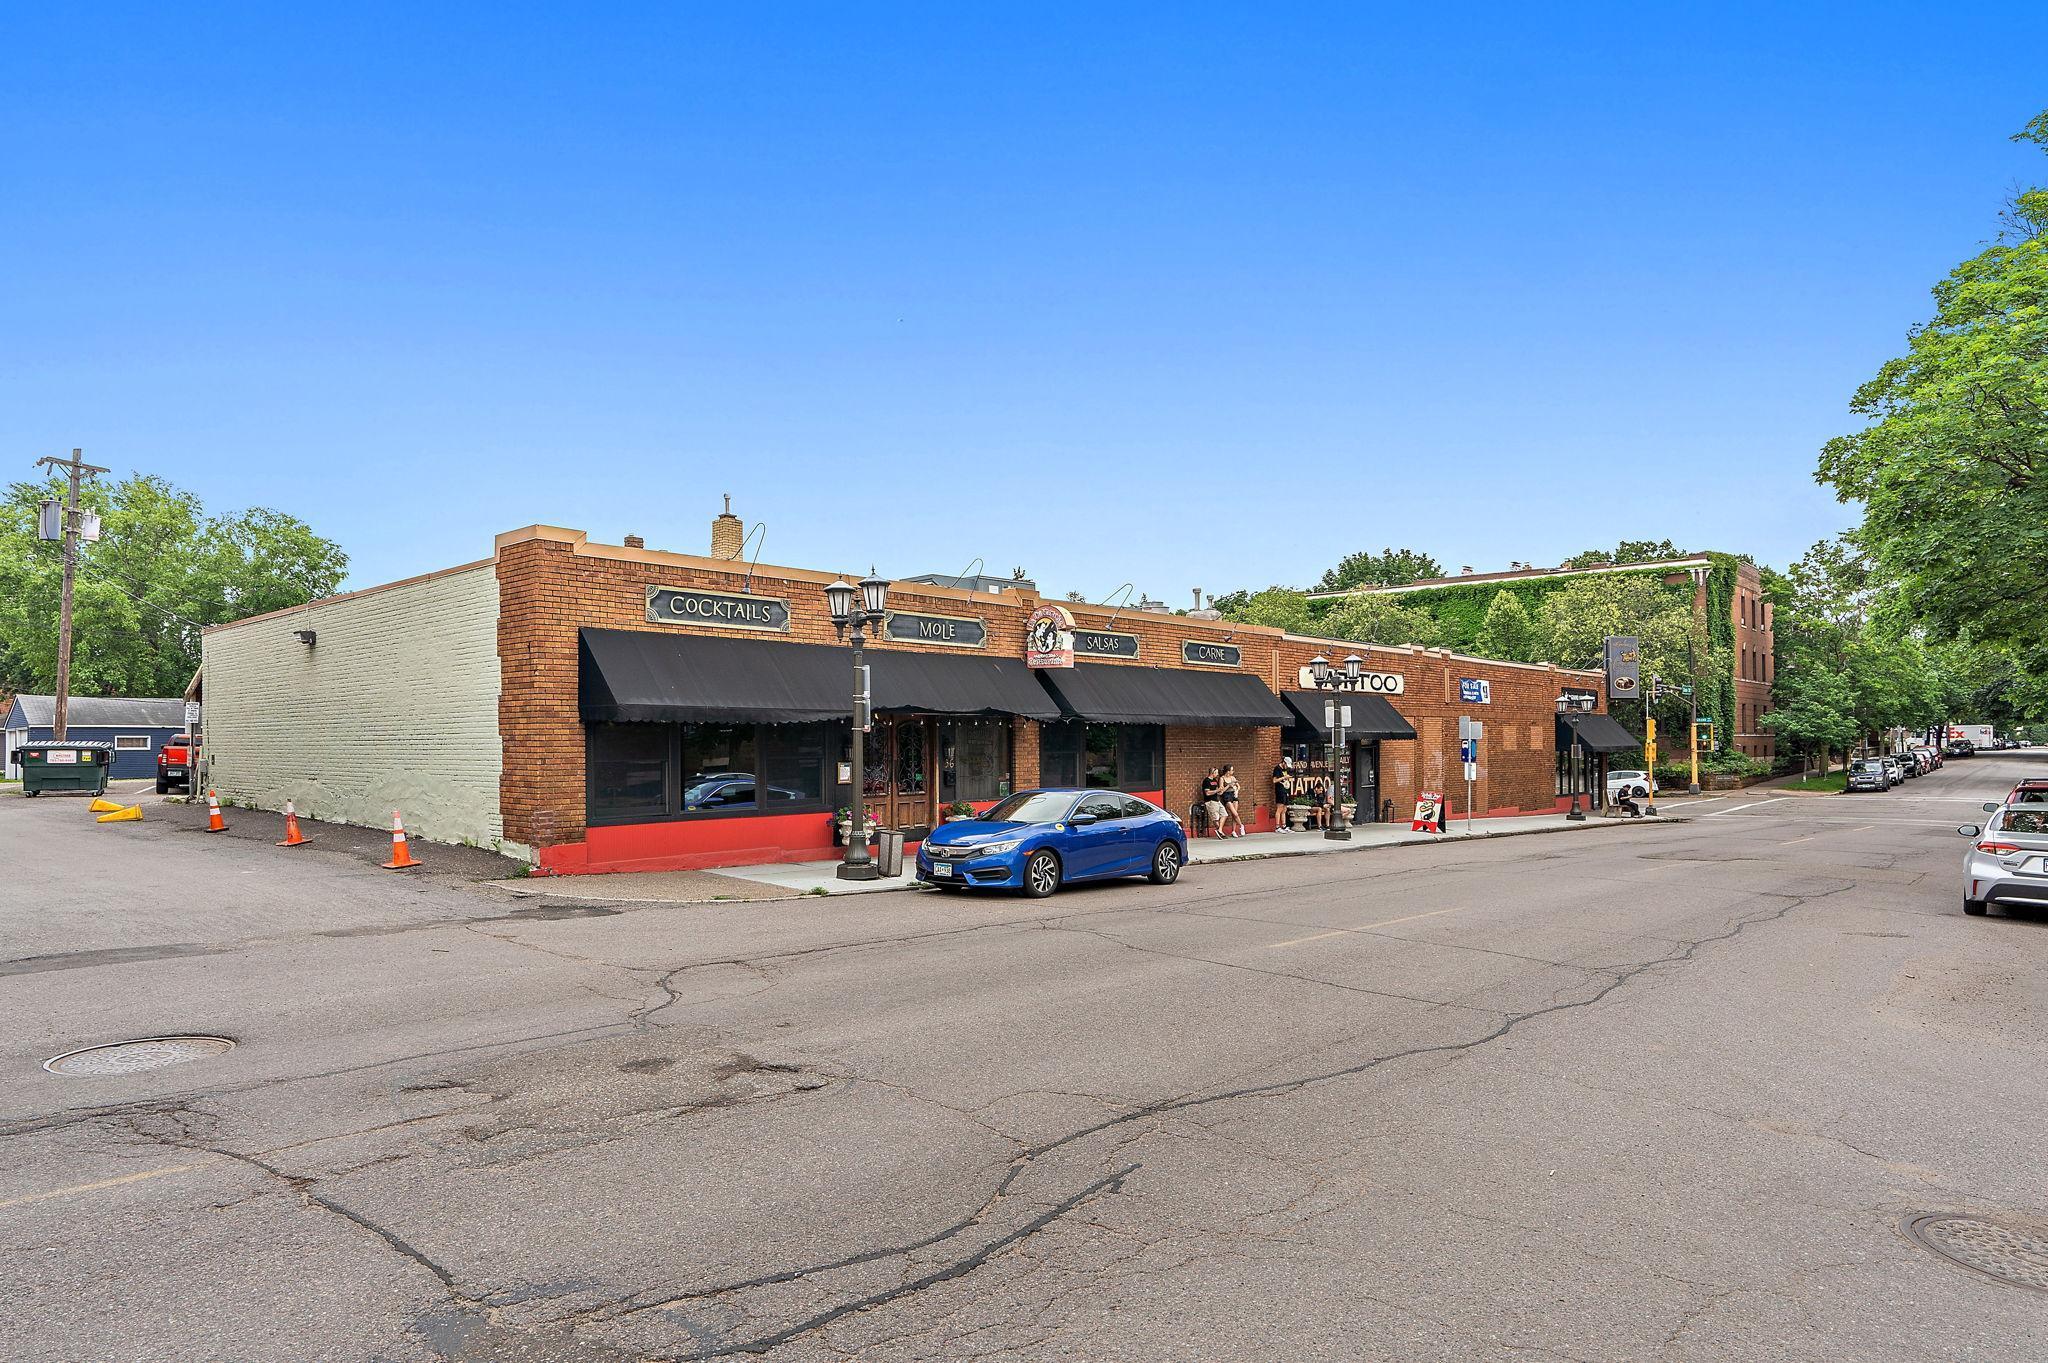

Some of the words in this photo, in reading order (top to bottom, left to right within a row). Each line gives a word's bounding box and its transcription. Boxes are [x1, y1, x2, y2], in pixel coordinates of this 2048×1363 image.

[670, 596, 771, 622] COCKTAILS
[919, 621, 956, 640] MOLE
[1086, 636, 1119, 651] SALSAS
[1198, 646, 1226, 661] CARNE
[1308, 669, 1398, 692] ATTOO
